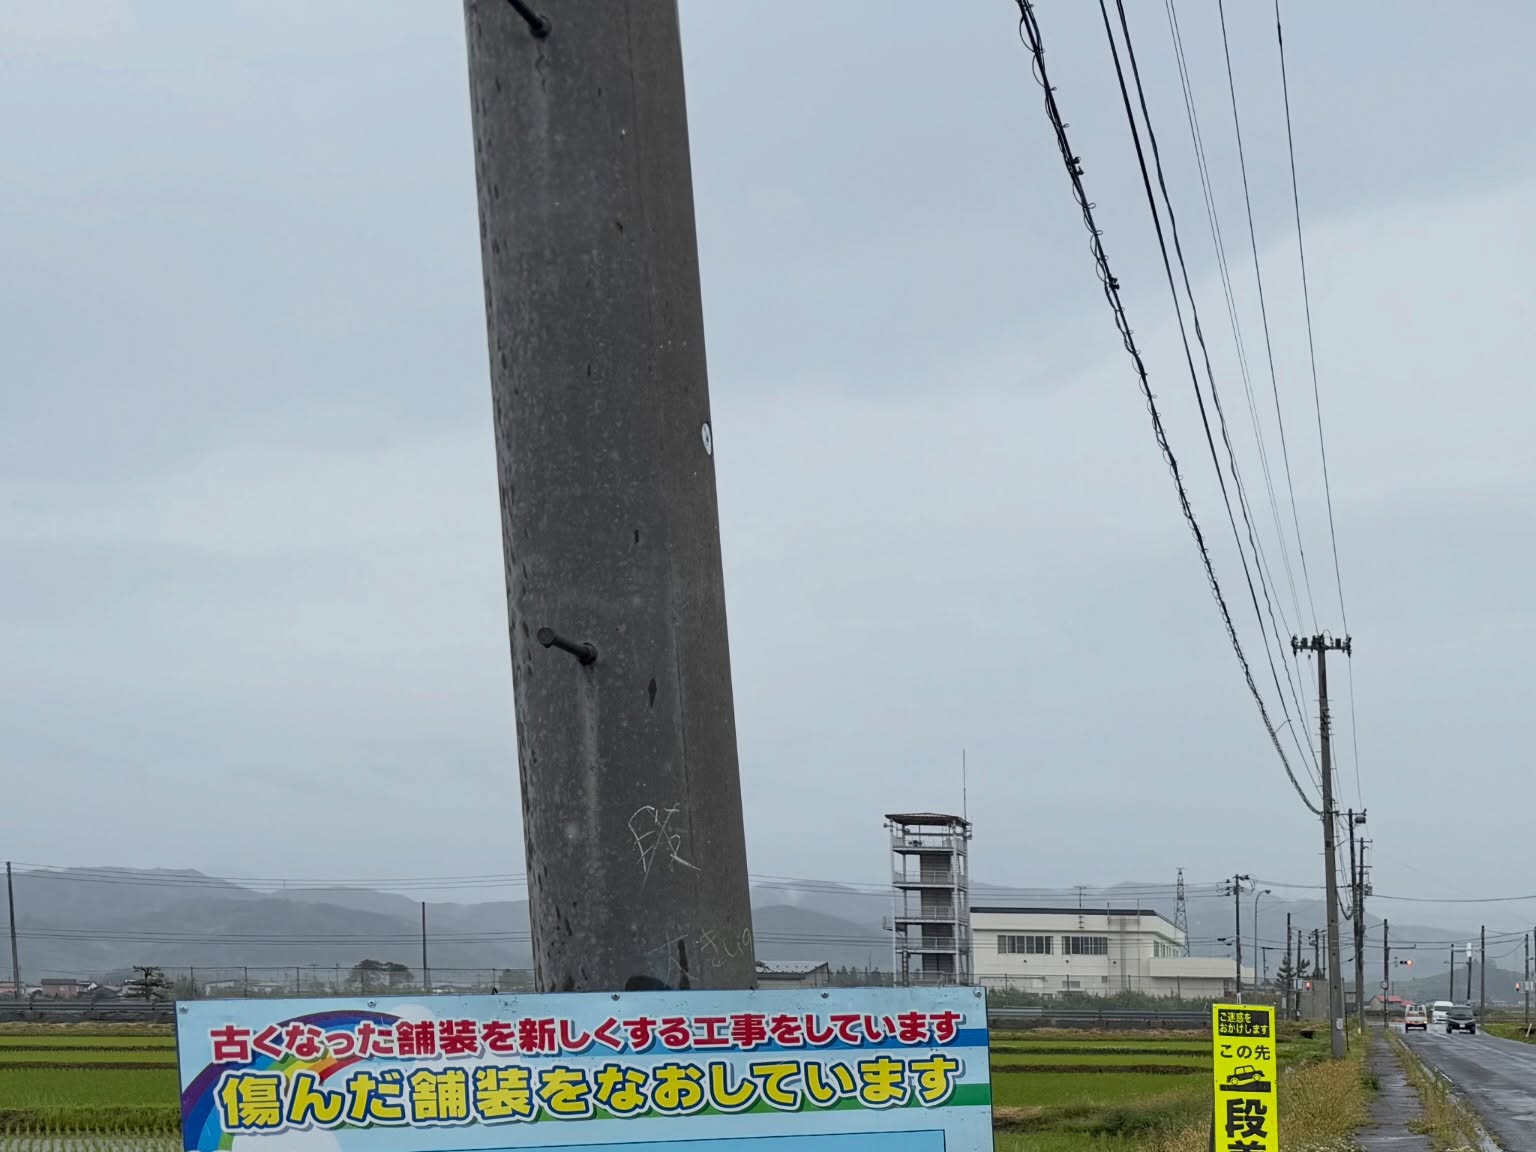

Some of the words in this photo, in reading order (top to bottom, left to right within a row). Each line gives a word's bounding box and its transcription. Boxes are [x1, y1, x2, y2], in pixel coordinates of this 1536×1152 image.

[211, 1011, 962, 1062] 古くなった舗装を新しくする工事をしています
[1219, 1023, 1269, 1035] おかけします
[1220, 1044, 1271, 1060] この先
[222, 1056, 961, 1129] 傷んだ舗装をなおしています
